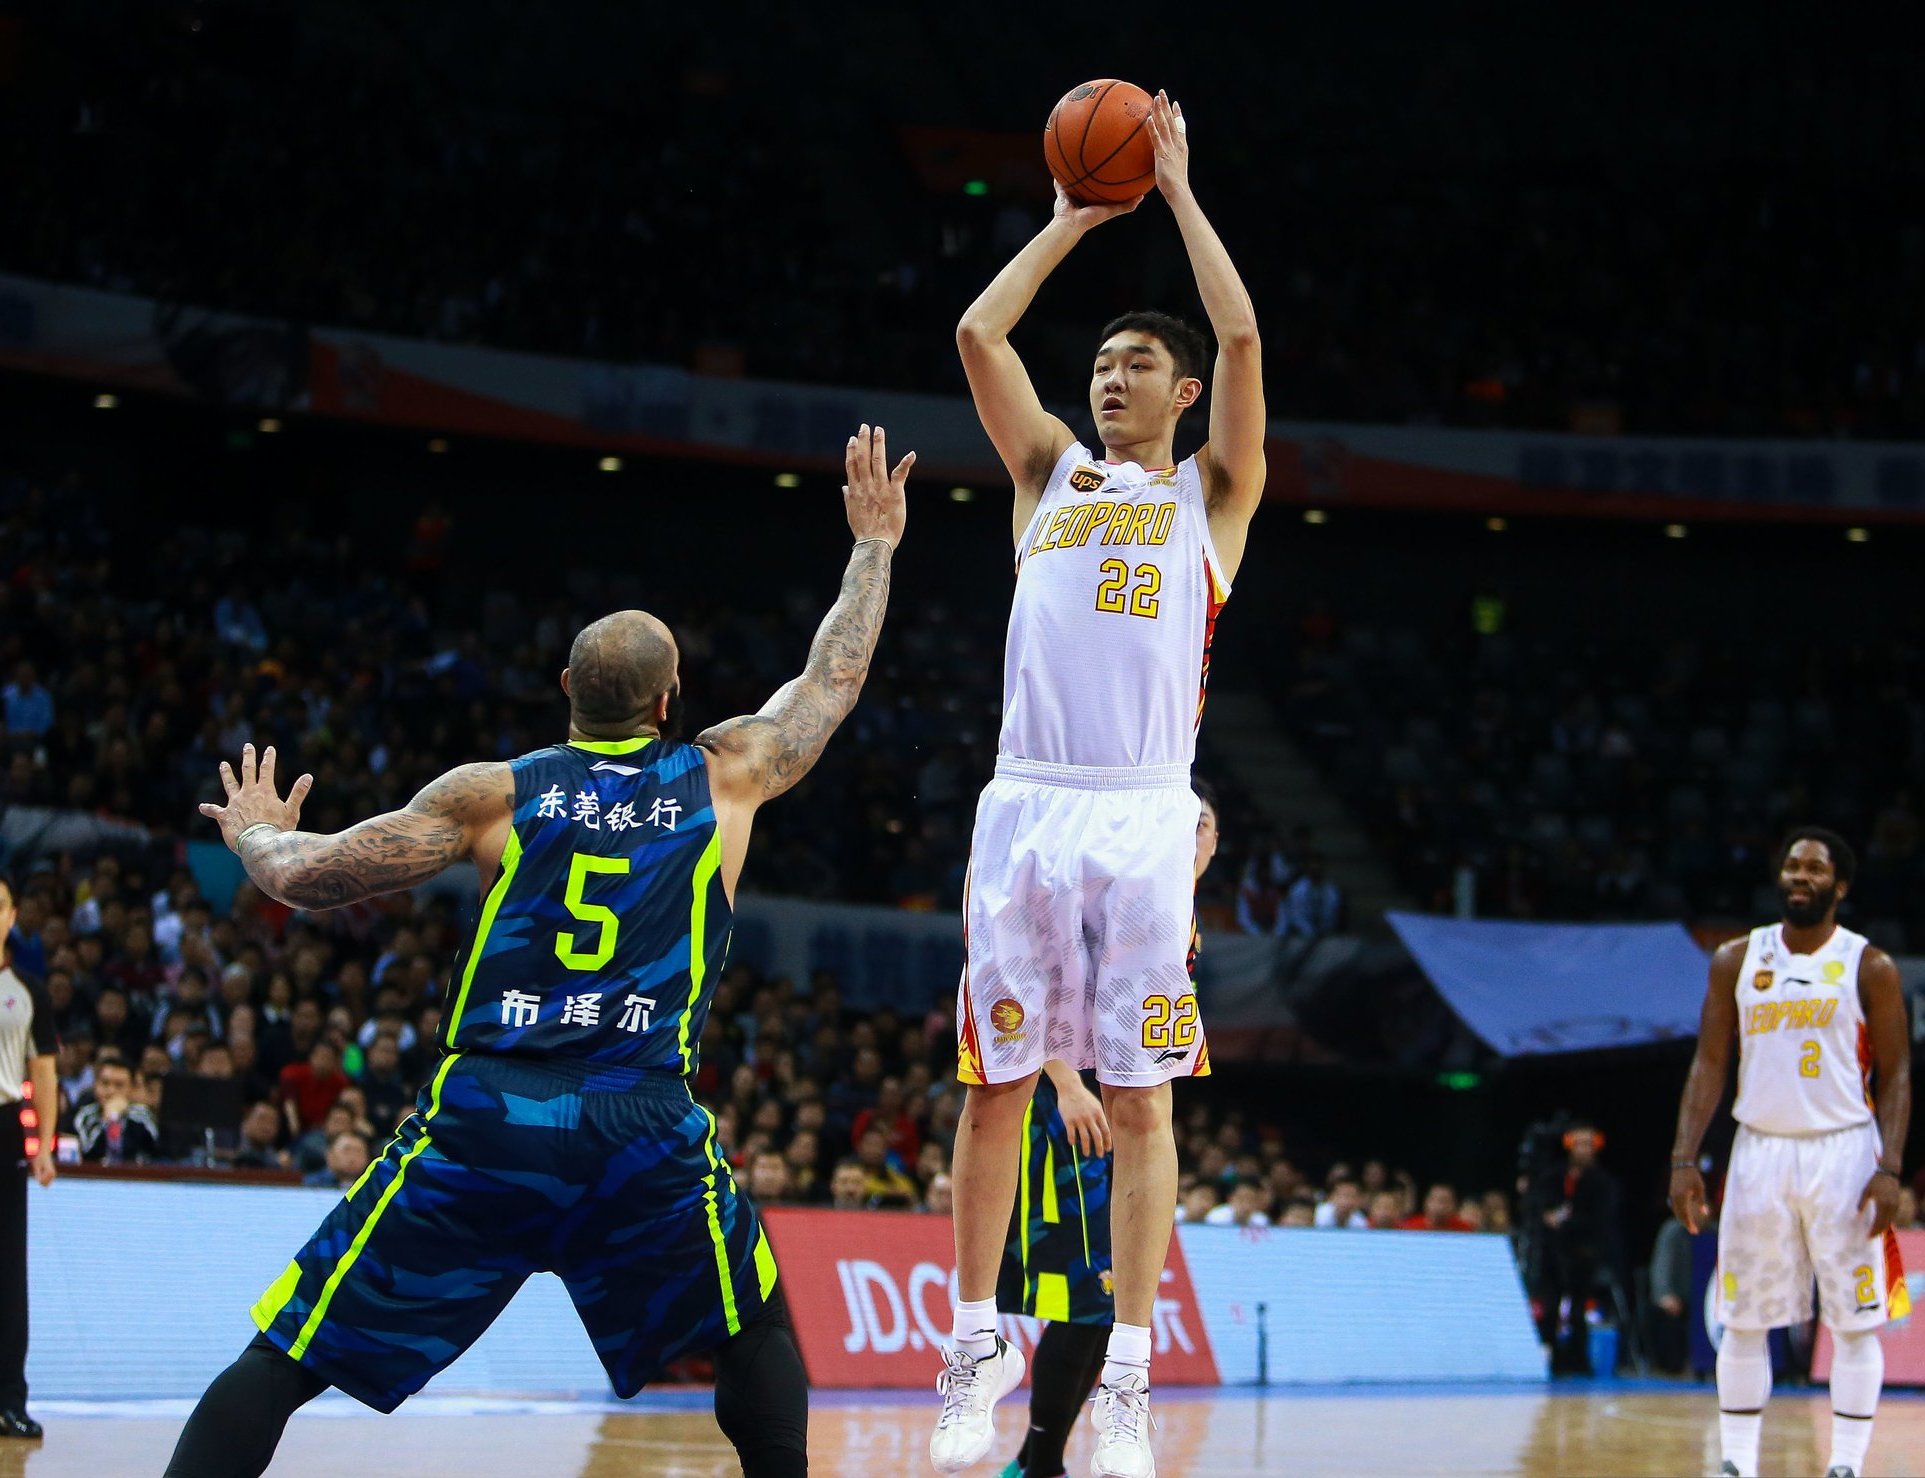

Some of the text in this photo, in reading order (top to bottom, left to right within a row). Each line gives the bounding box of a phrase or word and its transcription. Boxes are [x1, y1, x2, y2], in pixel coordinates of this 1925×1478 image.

[1071, 472, 1100, 490] ups
[1028, 501, 1177, 557] LEOPARD
[1095, 557, 1162, 619] 22
[536, 783, 682, 832] 东莞银行
[554, 851, 630, 971] 5
[500, 988, 657, 1033] 布泽尔
[1141, 993, 1198, 1049] 22
[1745, 998, 1839, 1036] LEOPARD
[1798, 1039, 1823, 1079] 2
[1853, 1264, 1876, 1304] 2
